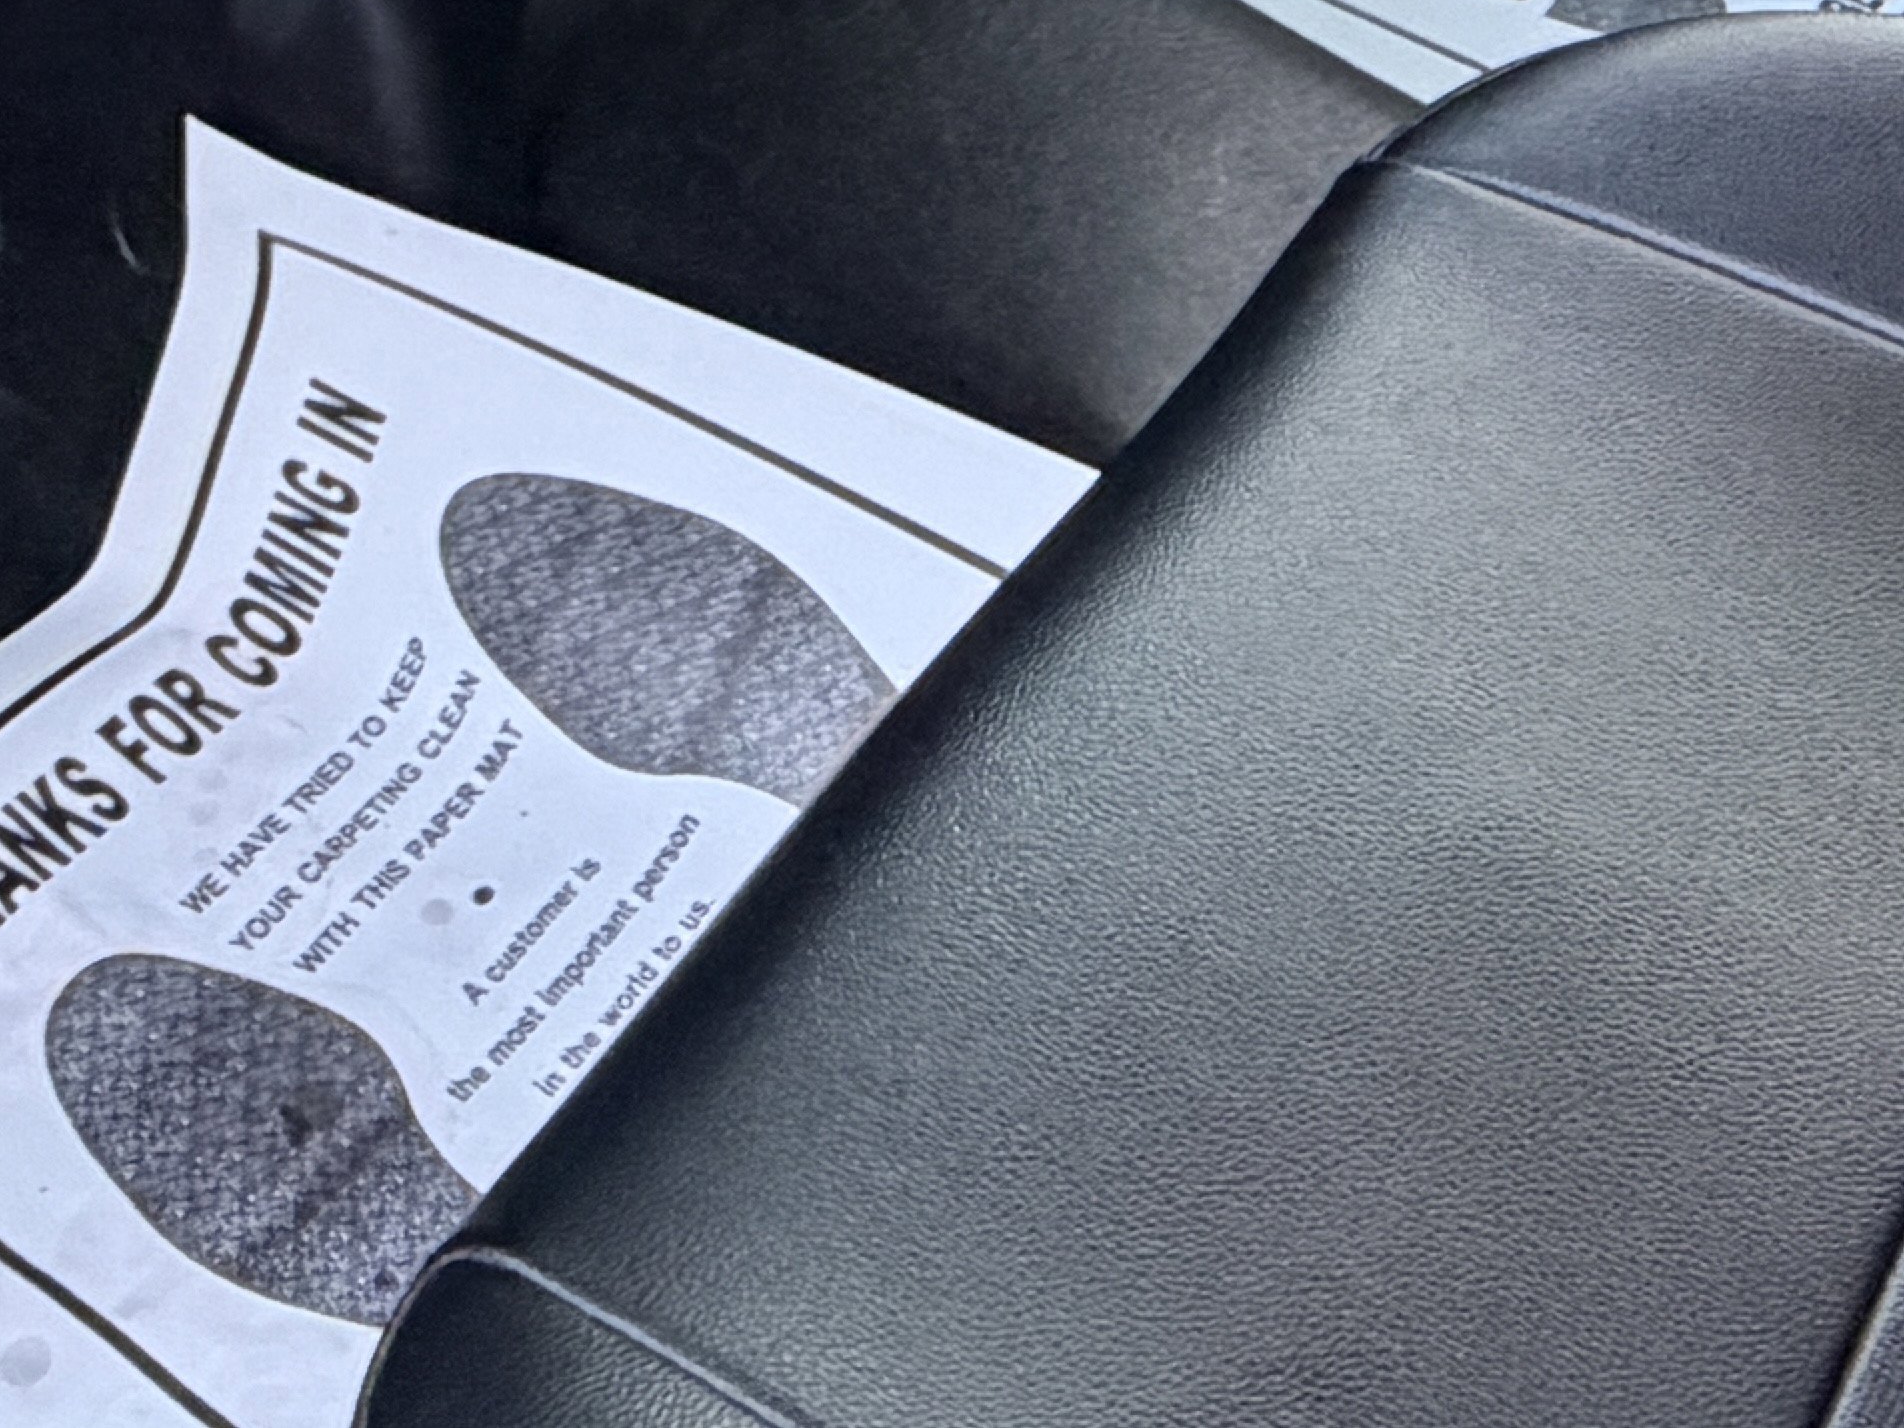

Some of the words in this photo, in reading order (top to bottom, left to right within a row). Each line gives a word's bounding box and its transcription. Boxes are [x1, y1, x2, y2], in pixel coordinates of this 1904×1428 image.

[96, 667, 240, 784] FOR
[205, 456, 360, 687] COMING
[296, 377, 388, 463] IN
[178, 872, 227, 915] WE
[220, 811, 292, 881] HAVE
[284, 751, 355, 818] TRIED
[351, 715, 387, 754] TO
[382, 635, 430, 718] KEEP
[228, 886, 304, 952] YOUR
[298, 759, 424, 885] CARPETING
[418, 670, 483, 761] CLEAN
[292, 907, 363, 974] WITH
[351, 857, 412, 913] THIS
[404, 784, 483, 862] PAPER
[477, 717, 525, 786] MAT
[447, 1062, 490, 1102] the
[487, 1008, 544, 1070] most
[535, 898, 638, 1012] important
[632, 810, 699, 913] person
[462, 980, 489, 1007] A
[483, 884, 582, 985] customer
[578, 855, 601, 888] is
[532, 1068, 565, 1099] in
[559, 1030, 601, 1074] the
[599, 960, 658, 1030] world
[653, 930, 682, 961] to
